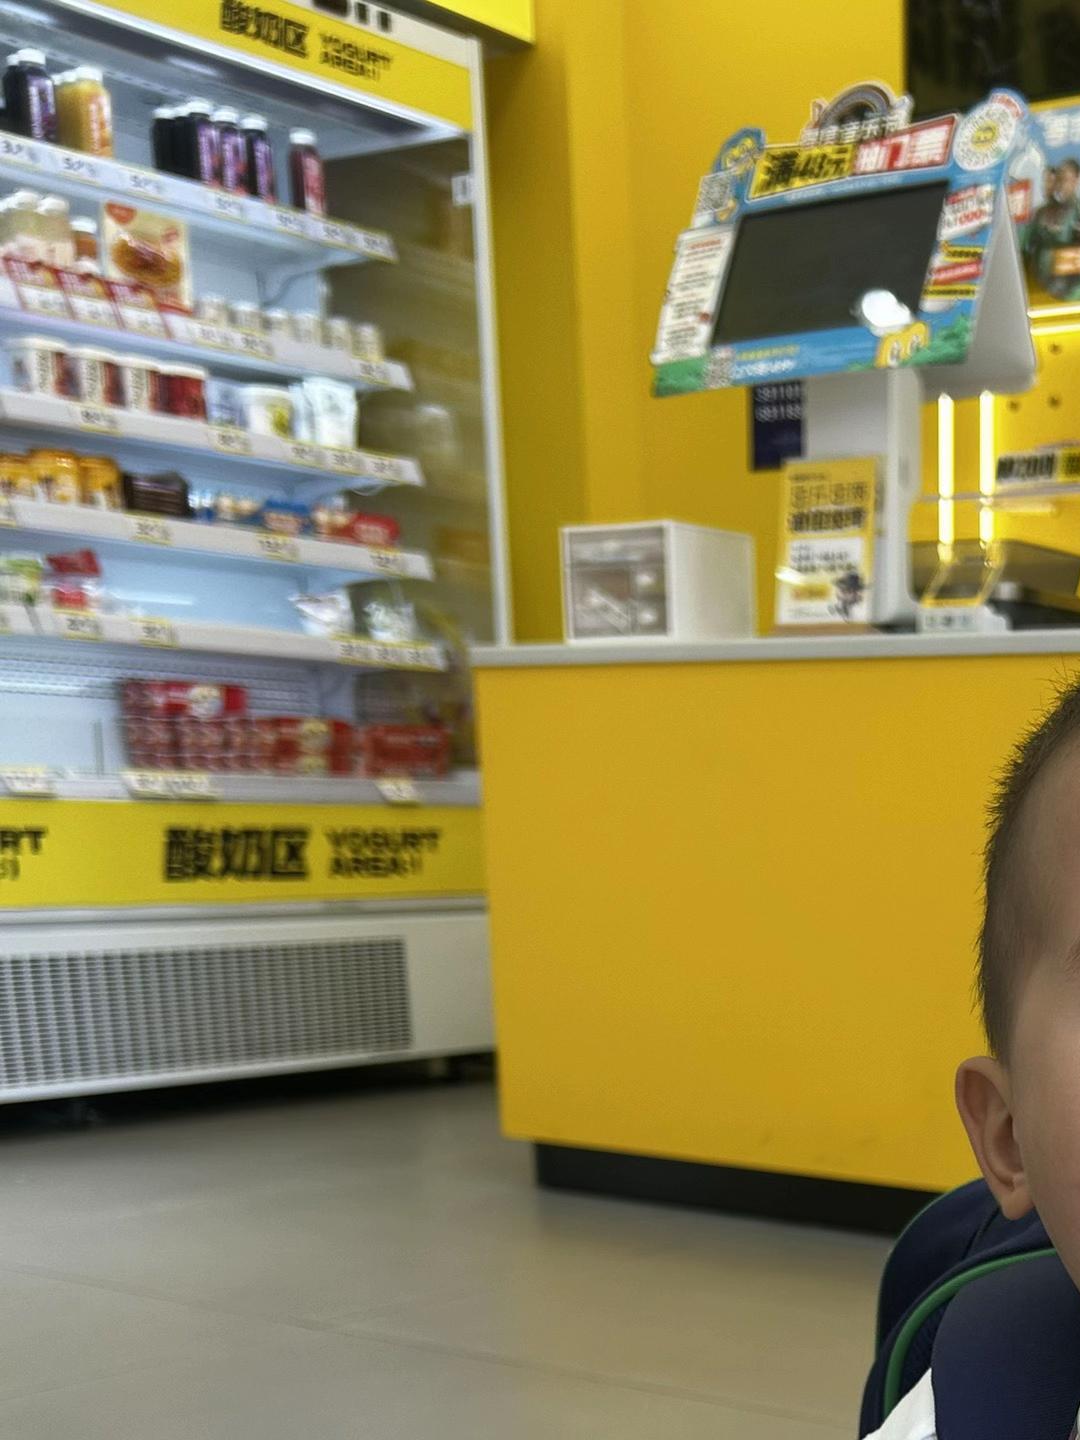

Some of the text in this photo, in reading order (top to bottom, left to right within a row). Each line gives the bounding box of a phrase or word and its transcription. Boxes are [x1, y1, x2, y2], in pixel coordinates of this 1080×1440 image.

[164, 825, 311, 881] 酸奶区
[326, 829, 443, 857] YOGURT
